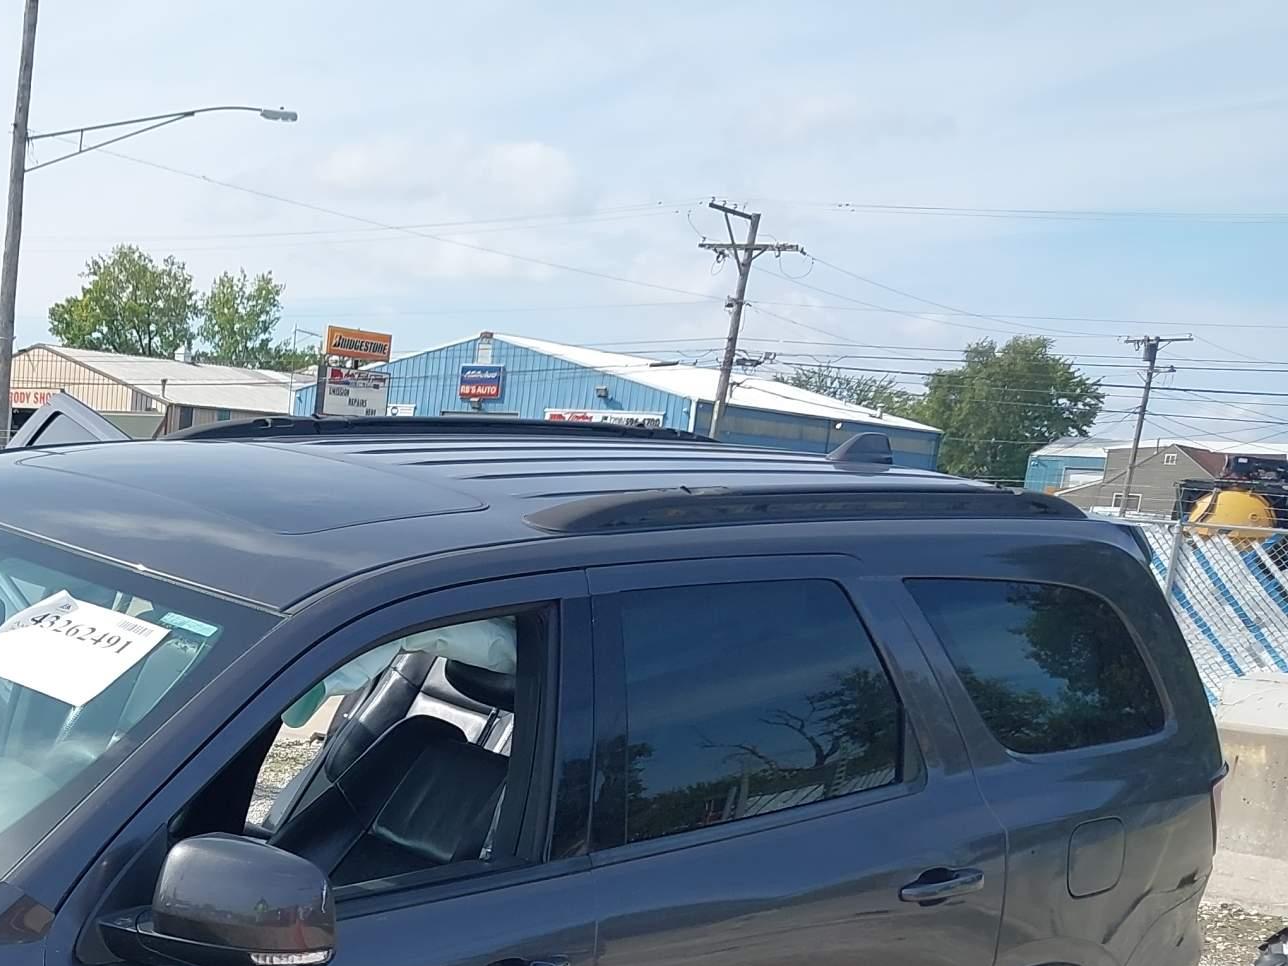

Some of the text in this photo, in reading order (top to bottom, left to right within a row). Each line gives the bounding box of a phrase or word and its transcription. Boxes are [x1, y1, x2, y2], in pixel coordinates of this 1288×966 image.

[332, 335, 389, 355] BRIDGESTONE
[476, 385, 497, 394] AUTO
[33, 391, 56, 405] SHO
[348, 398, 368, 408] REPAIRS
[30, 613, 133, 654] 43262491
